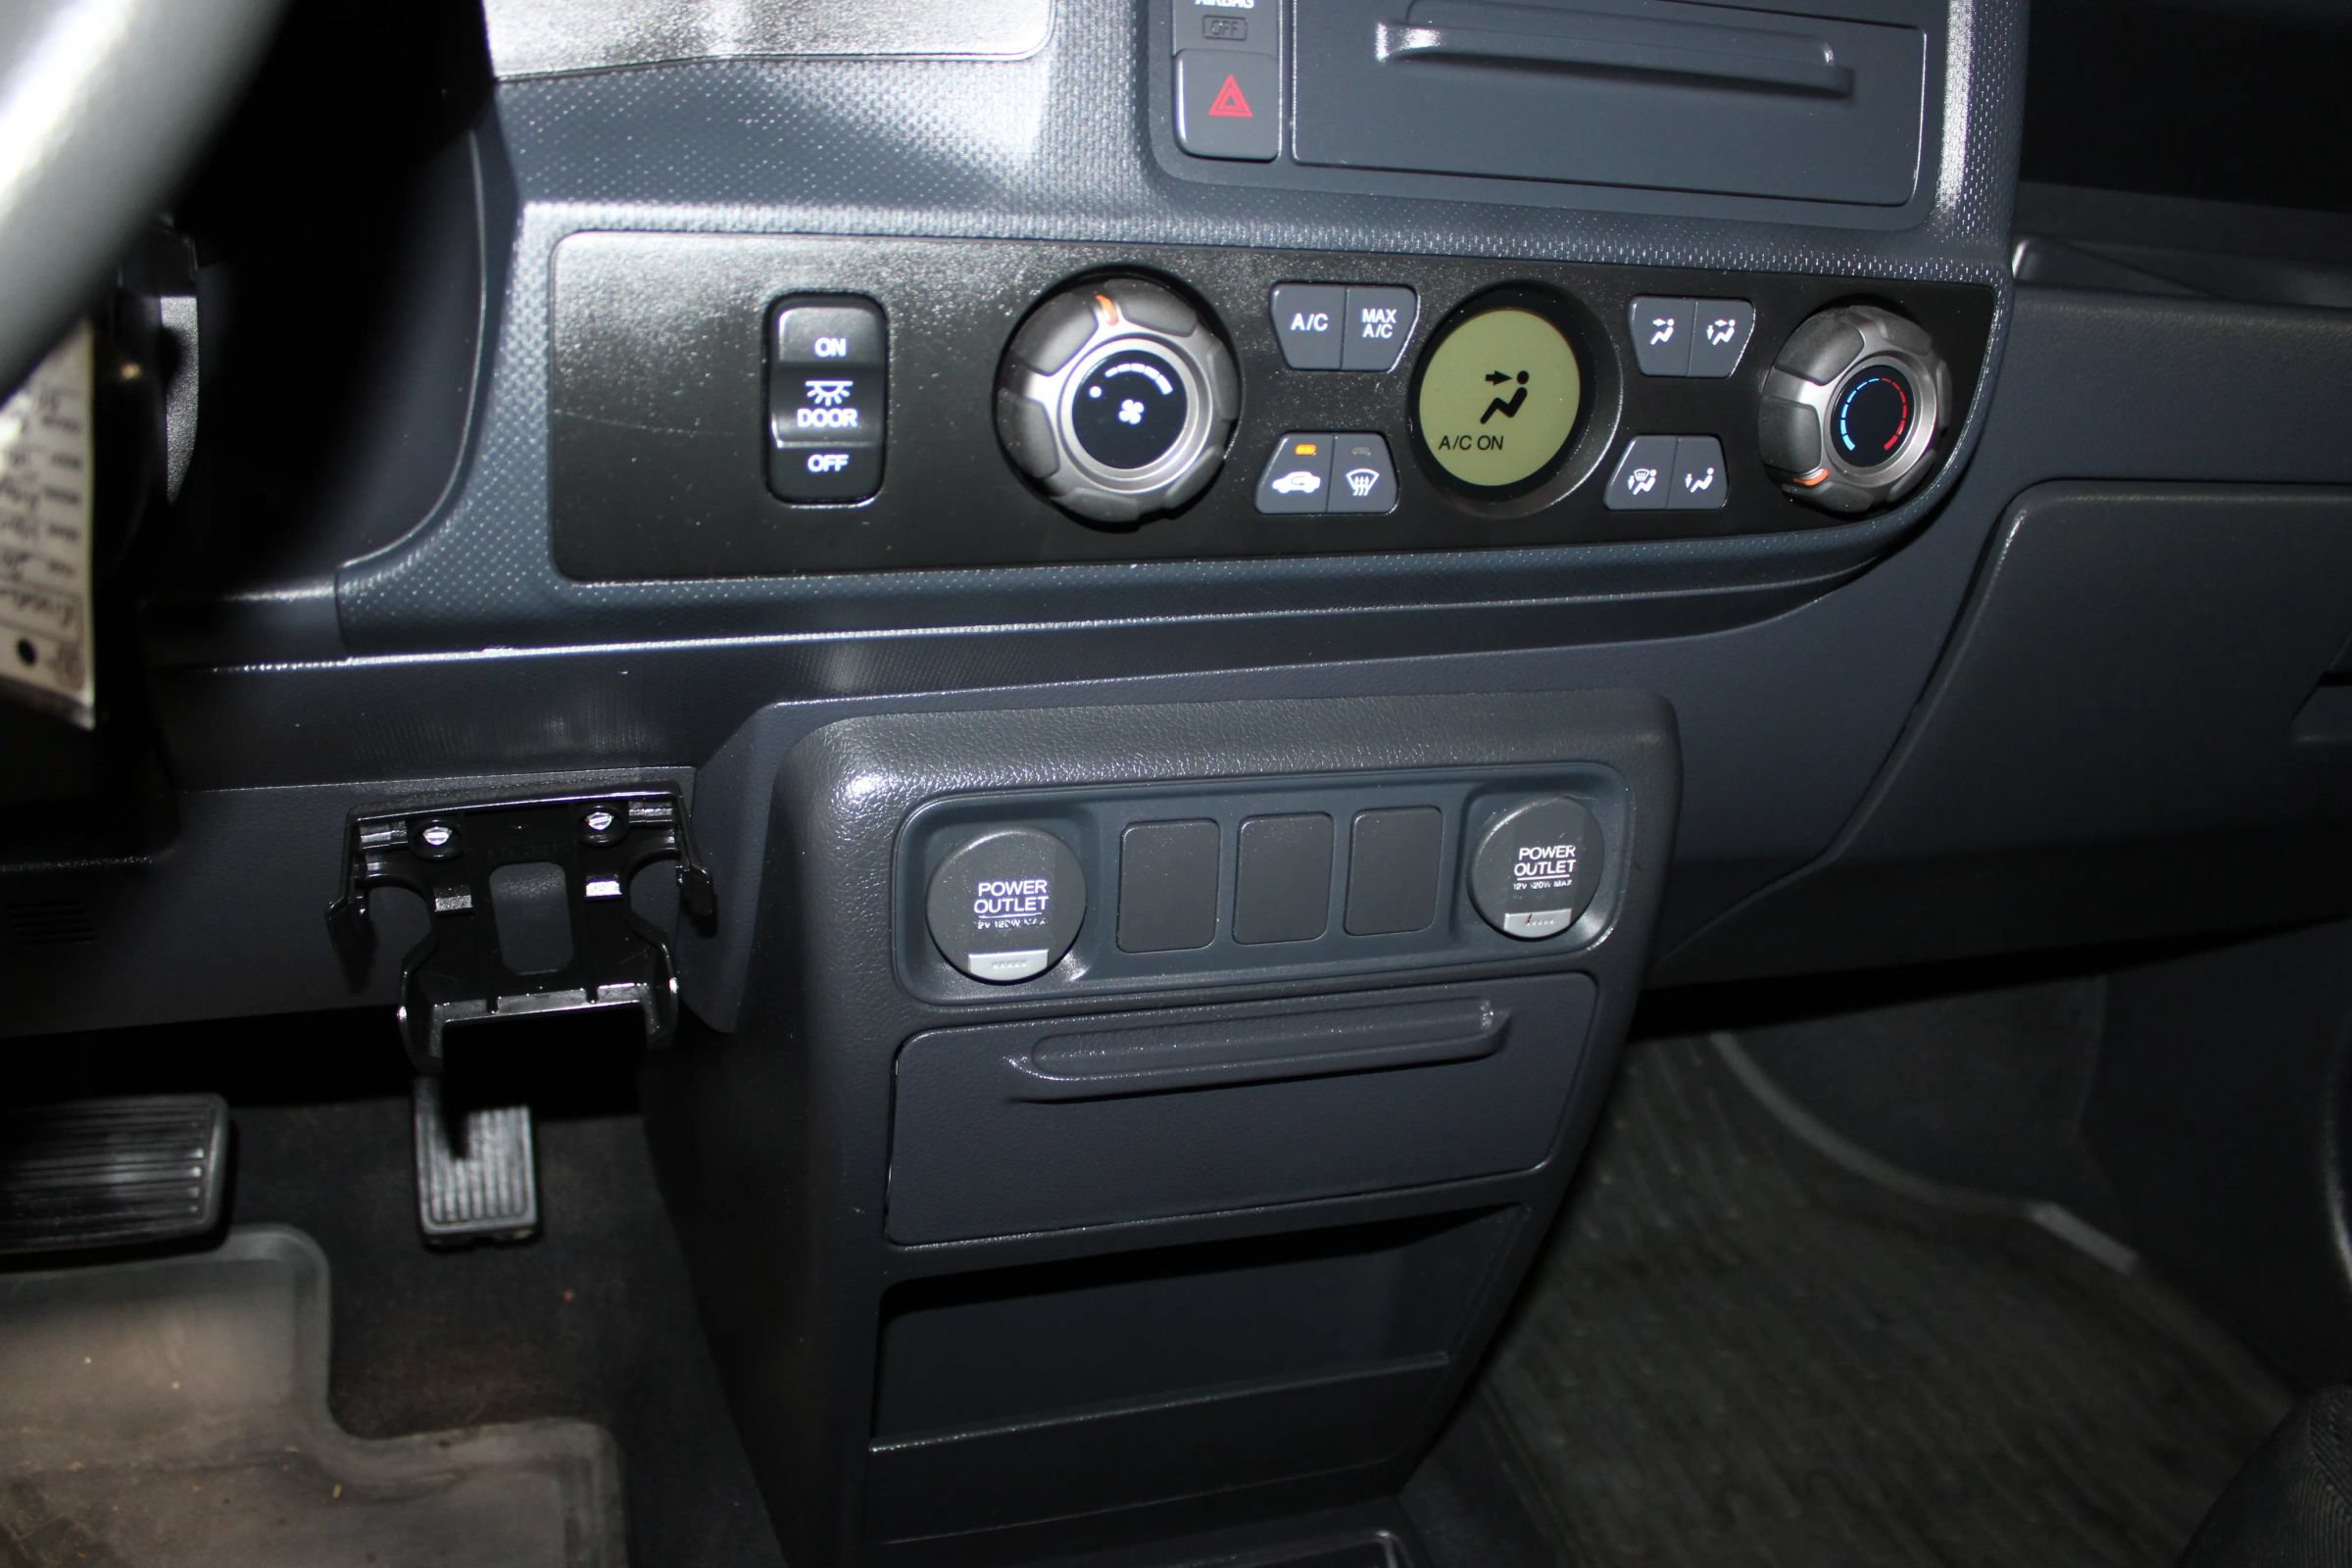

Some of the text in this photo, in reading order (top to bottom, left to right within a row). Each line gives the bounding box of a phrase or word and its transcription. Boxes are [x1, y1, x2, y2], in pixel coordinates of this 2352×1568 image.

[1210, 20, 1240, 37] OFF
[1290, 313, 1329, 331] A/C
[1361, 308, 1396, 323] MAX
[1361, 323, 1393, 338] A/C
[813, 337, 847, 357] ON
[797, 408, 858, 428] DOOR
[1438, 435, 1504, 451] A/C ON
[807, 454, 850, 472] OFF
[1518, 845, 1577, 861] POWER
[1513, 859, 1577, 877] OUTLET
[978, 879, 1048, 897] POWER
[973, 896, 1050, 913] OUTLET
[974, 919, 991, 930] 2V
